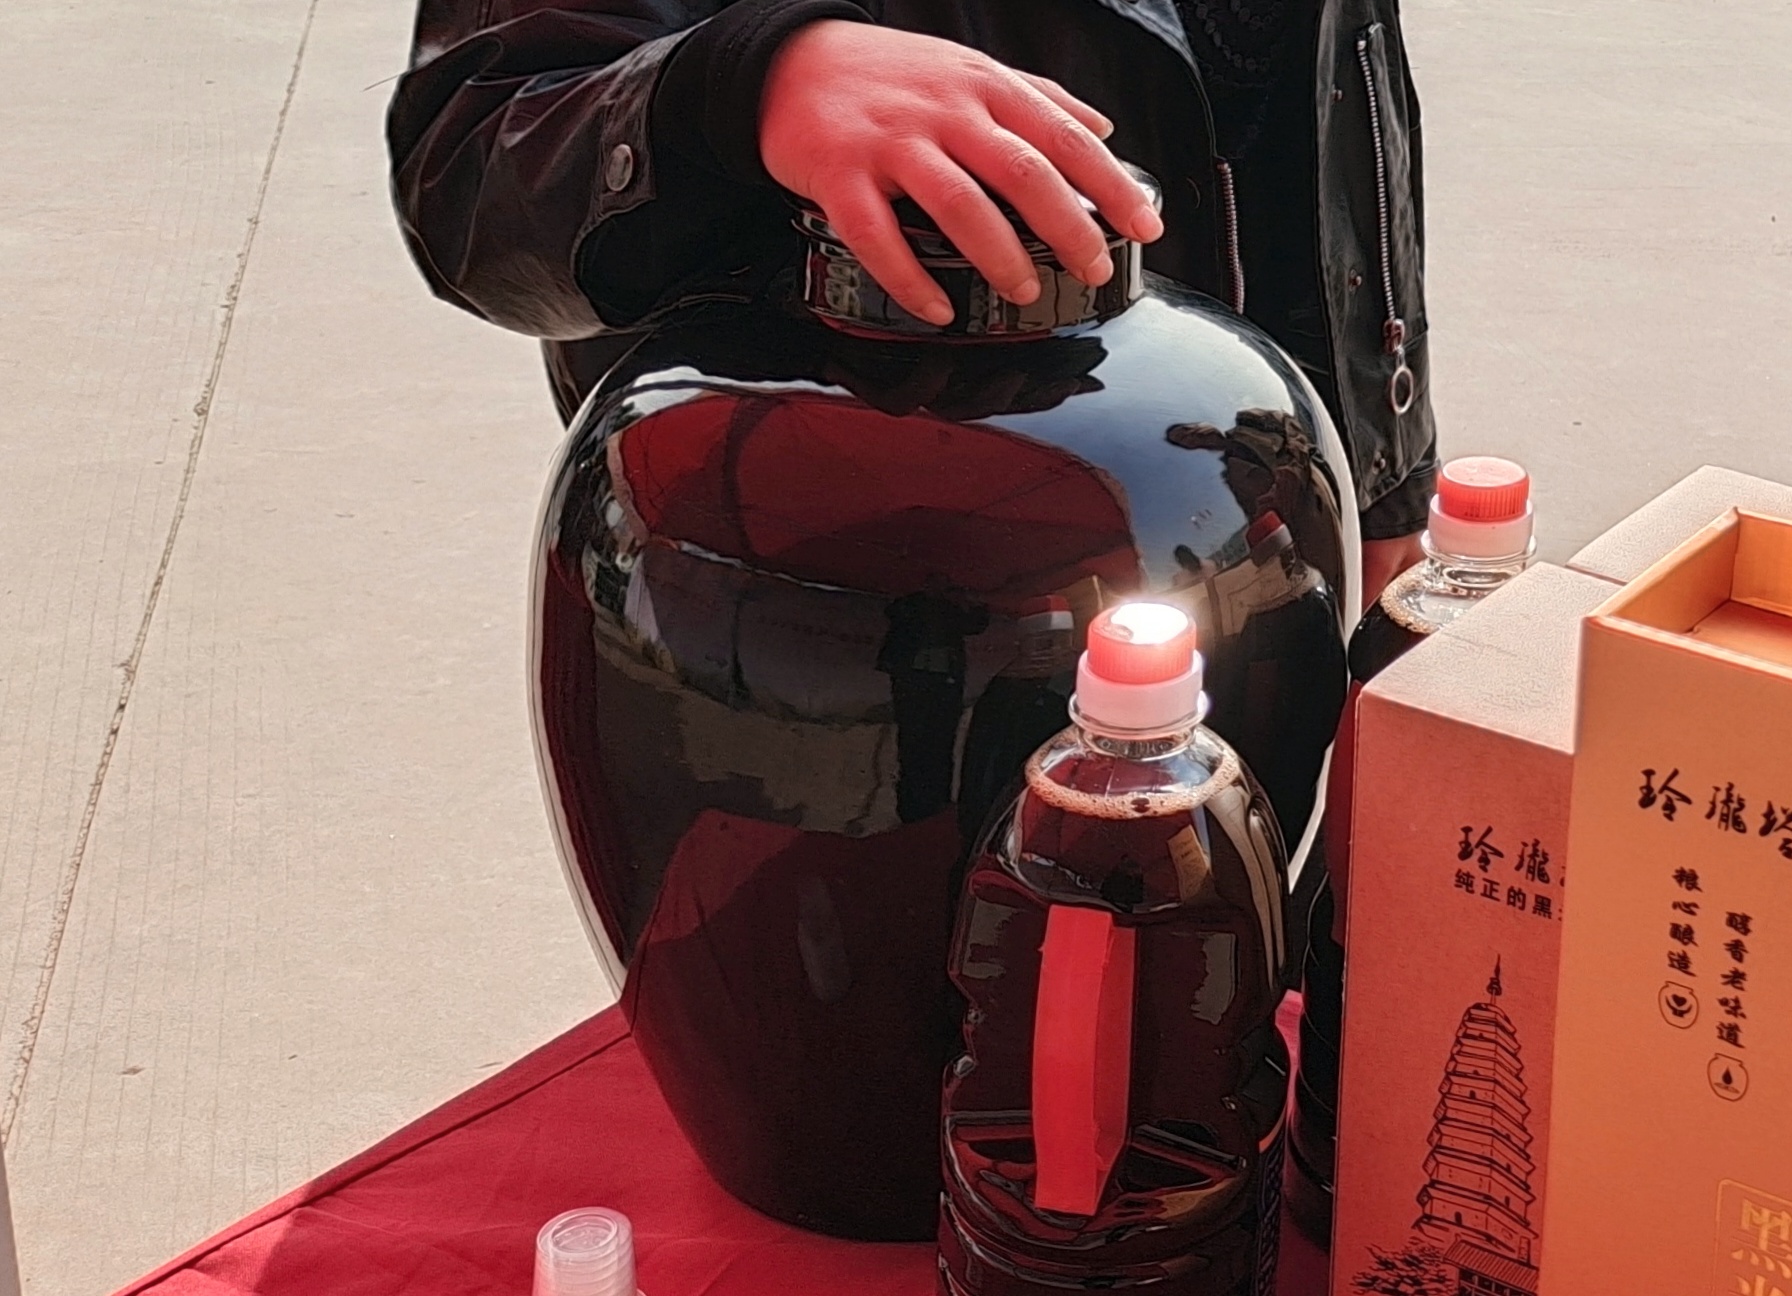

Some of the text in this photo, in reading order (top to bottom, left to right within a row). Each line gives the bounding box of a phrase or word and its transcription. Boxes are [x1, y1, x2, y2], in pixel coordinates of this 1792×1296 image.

[1457, 825, 1566, 887] 玲瓏
[1454, 868, 1563, 922] 纯正的黑
[1716, 911, 1753, 1049] 醇香老味道
